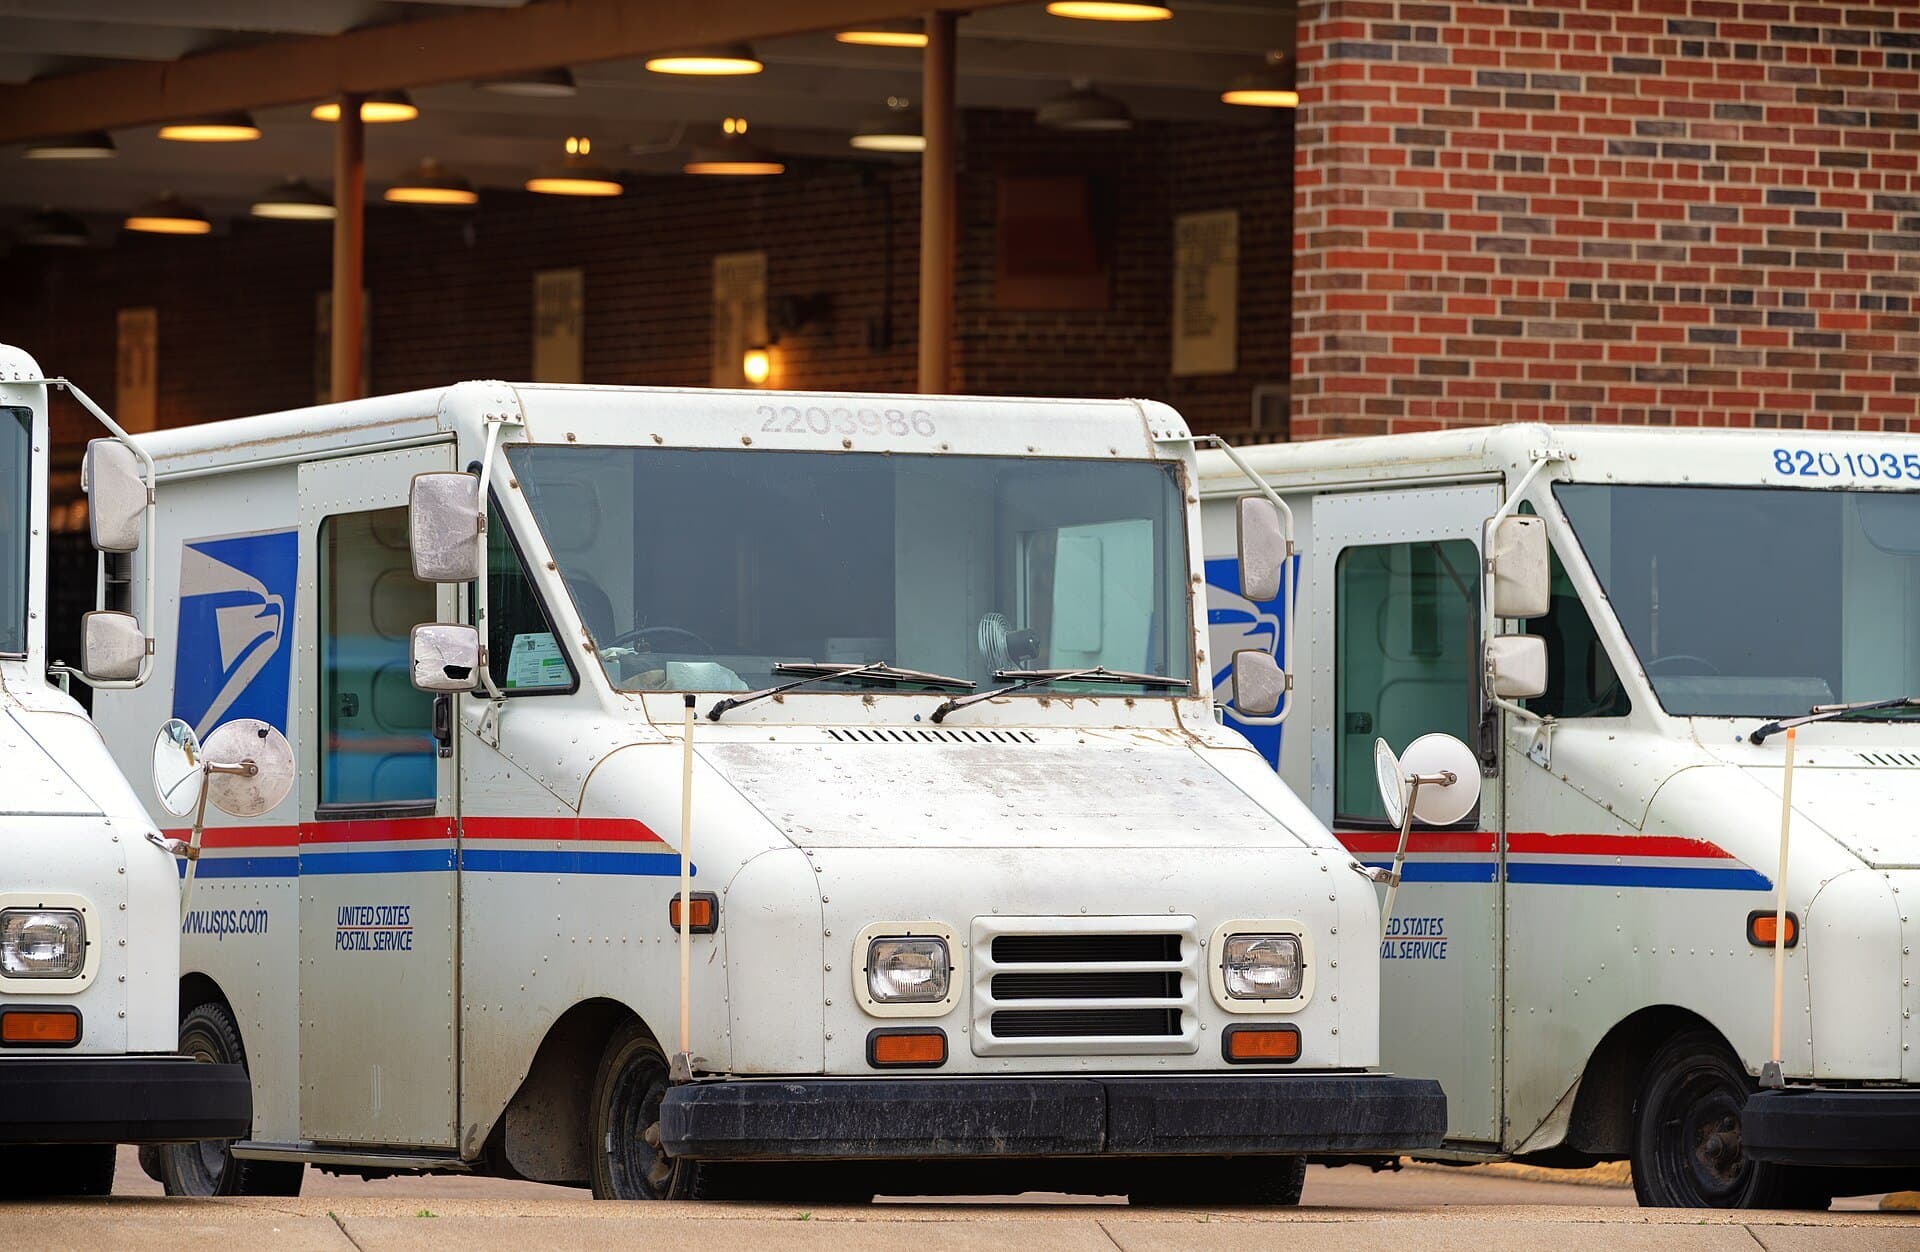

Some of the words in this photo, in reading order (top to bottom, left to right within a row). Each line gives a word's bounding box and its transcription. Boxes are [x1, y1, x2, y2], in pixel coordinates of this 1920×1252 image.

[756, 405, 937, 438] 2203986
[1772, 448, 1920, 480] 8201035
[182, 909, 268, 941] ww.usps.com
[337, 906, 375, 926] UNITED
[375, 905, 411, 926] STATES
[1402, 917, 1444, 936] STATES
[335, 931, 371, 951] POSTAL
[372, 930, 413, 951] SERVICE
[1399, 941, 1448, 960] SERVICE
